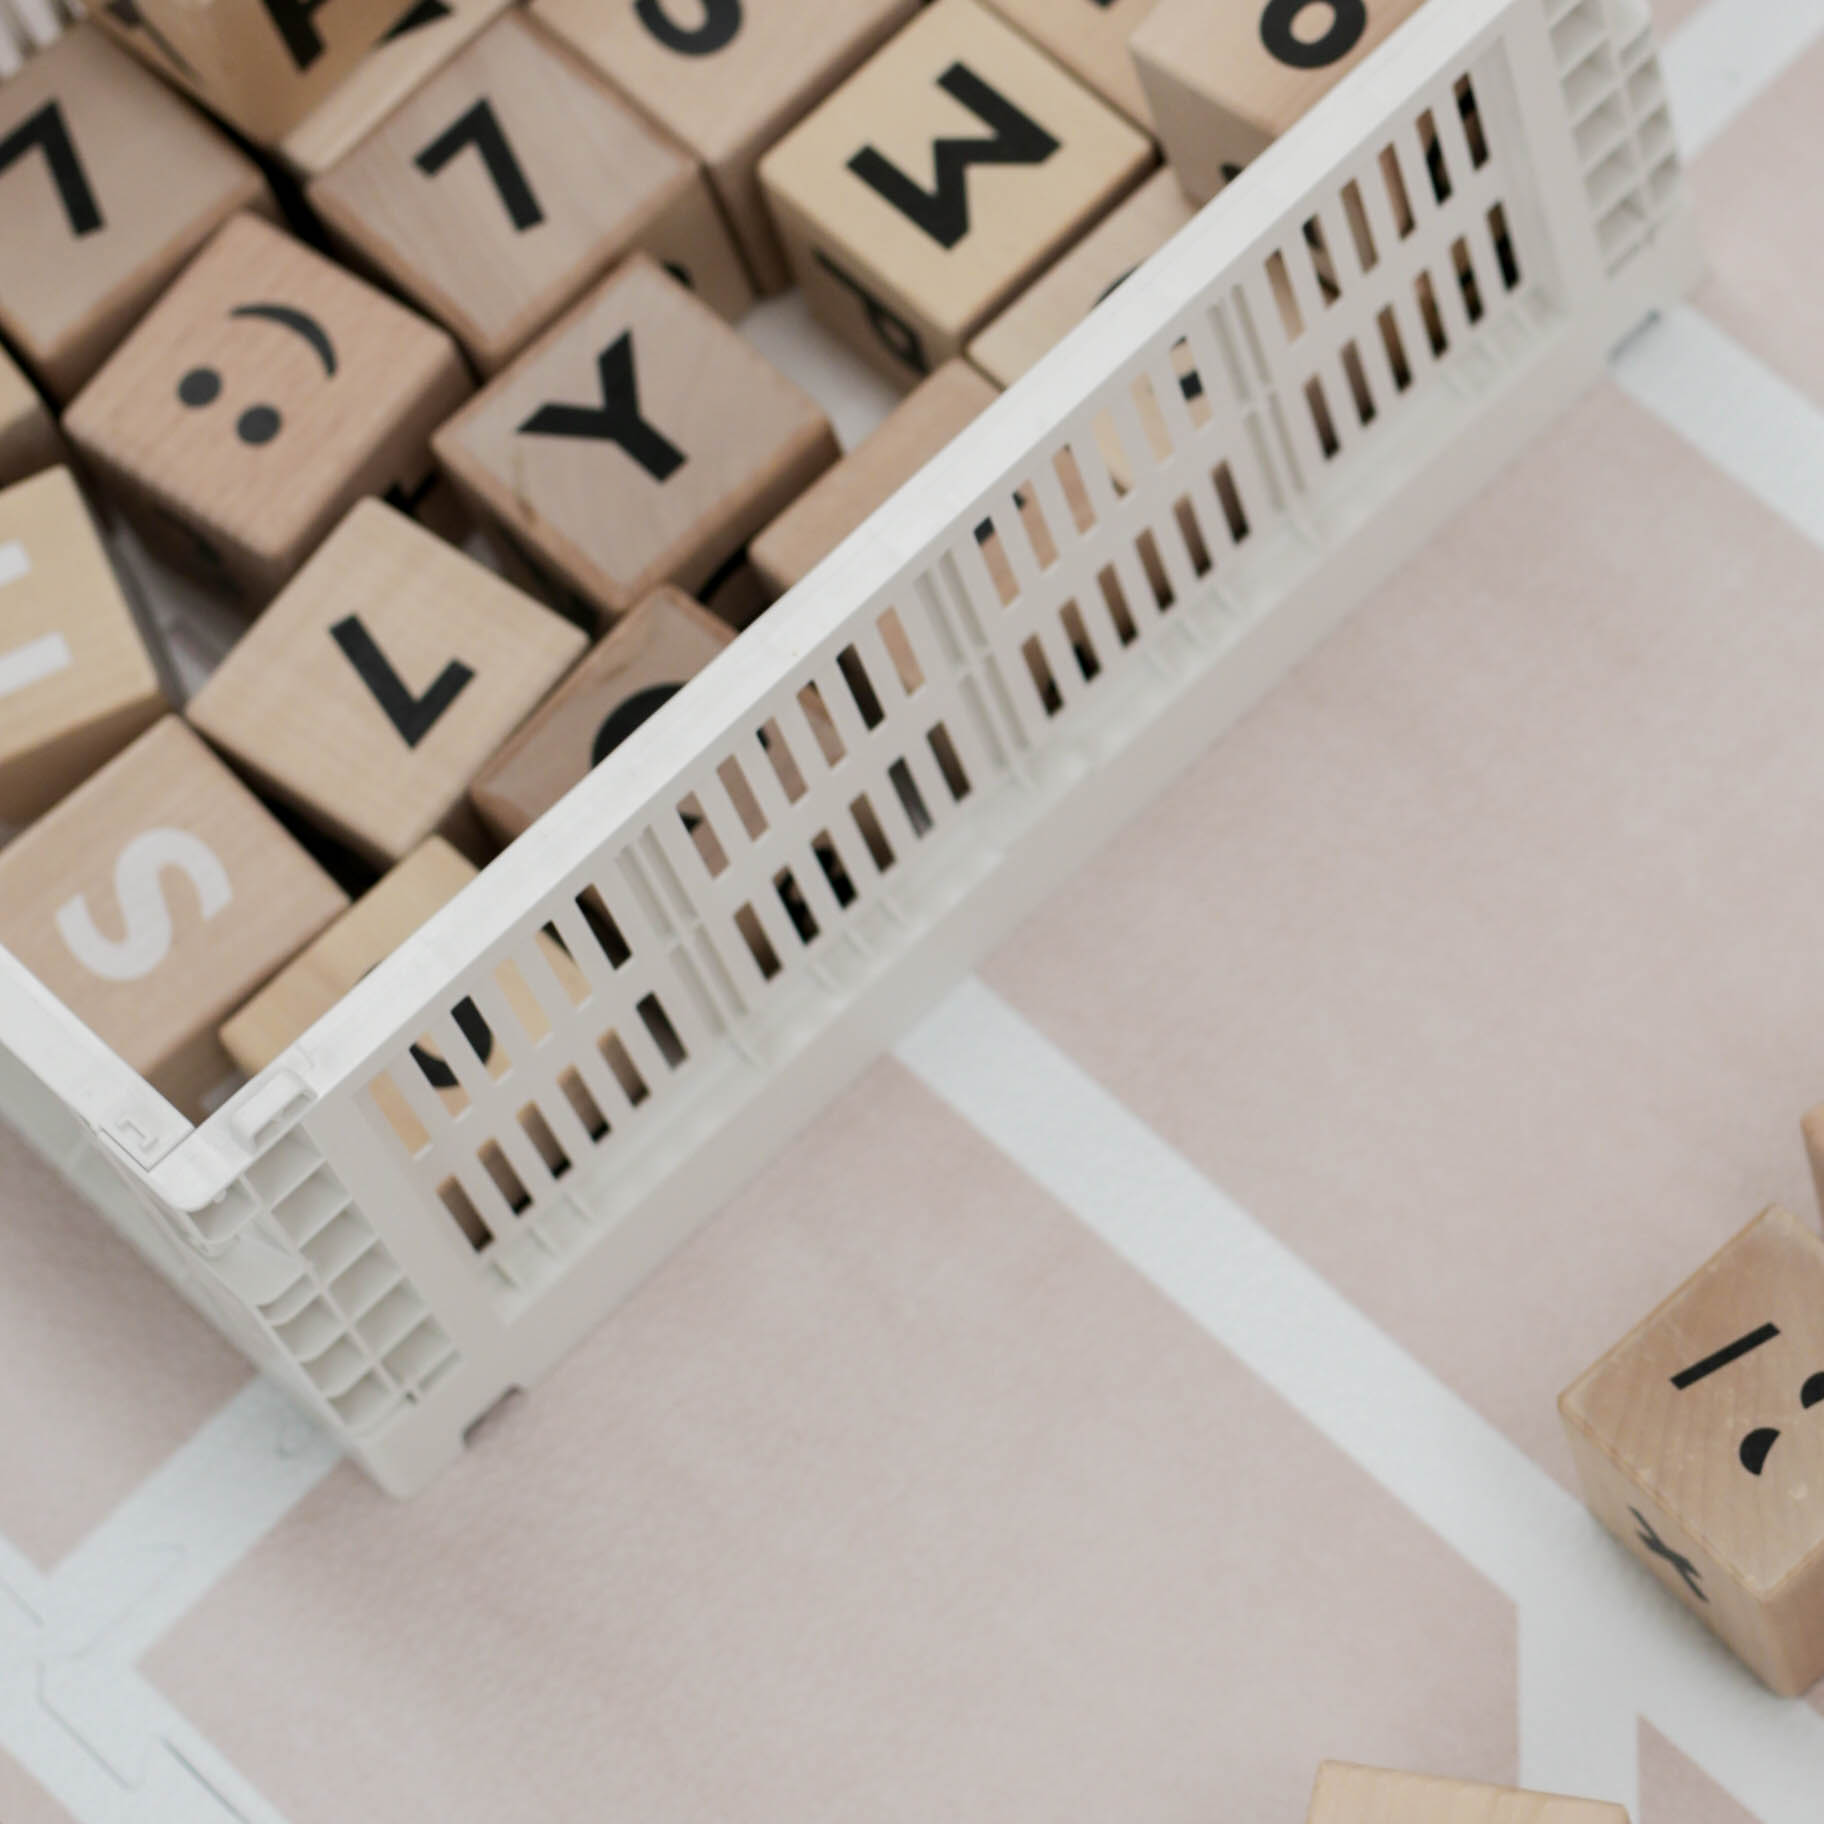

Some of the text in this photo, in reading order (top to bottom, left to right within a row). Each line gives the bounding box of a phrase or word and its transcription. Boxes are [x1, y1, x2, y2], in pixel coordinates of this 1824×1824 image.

[0, 101, 103, 236] 7
[414, 99, 544, 231] 7
[518, 332, 686, 482] Y
[56, 828, 232, 979] S
